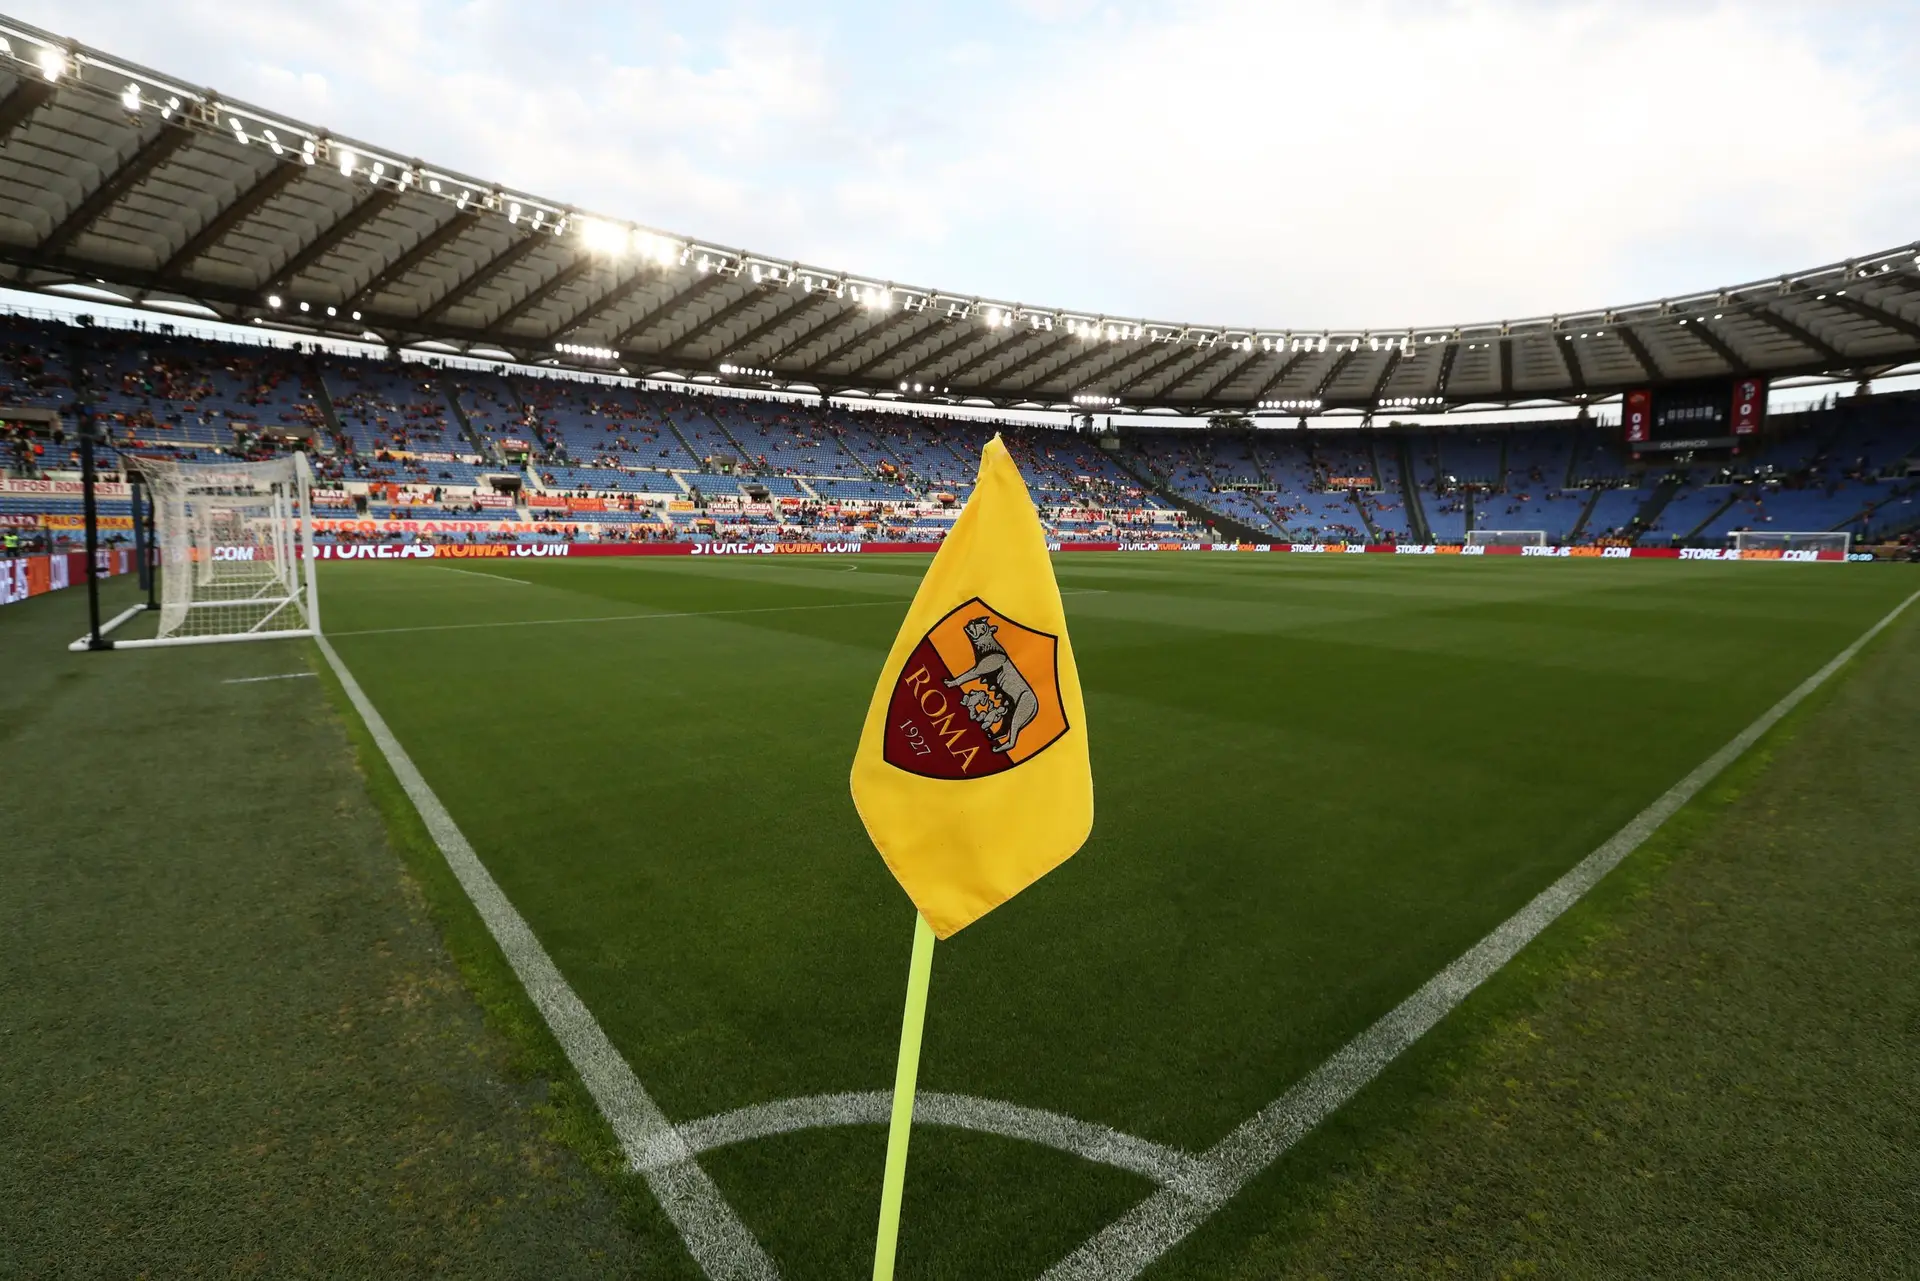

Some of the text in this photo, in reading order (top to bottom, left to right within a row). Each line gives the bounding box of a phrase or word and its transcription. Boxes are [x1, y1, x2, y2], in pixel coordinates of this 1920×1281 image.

[10, 481, 51, 491] TIFOSI
[55, 482, 124, 494] ROMNISTI
[295, 521, 377, 532] NICO
[384, 521, 488, 532] GRANDE
[1290, 545, 1365, 553] STORE.ASROMA.COM
[1395, 545, 1485, 554] STORE.ASROMA.COM
[1521, 546, 1631, 557] STORE.ASROMA.COM
[1678, 548, 1818, 560] STORE.ASROMA.COM
[904, 664, 980, 773] ROMA
[898, 718, 932, 756] 1927
